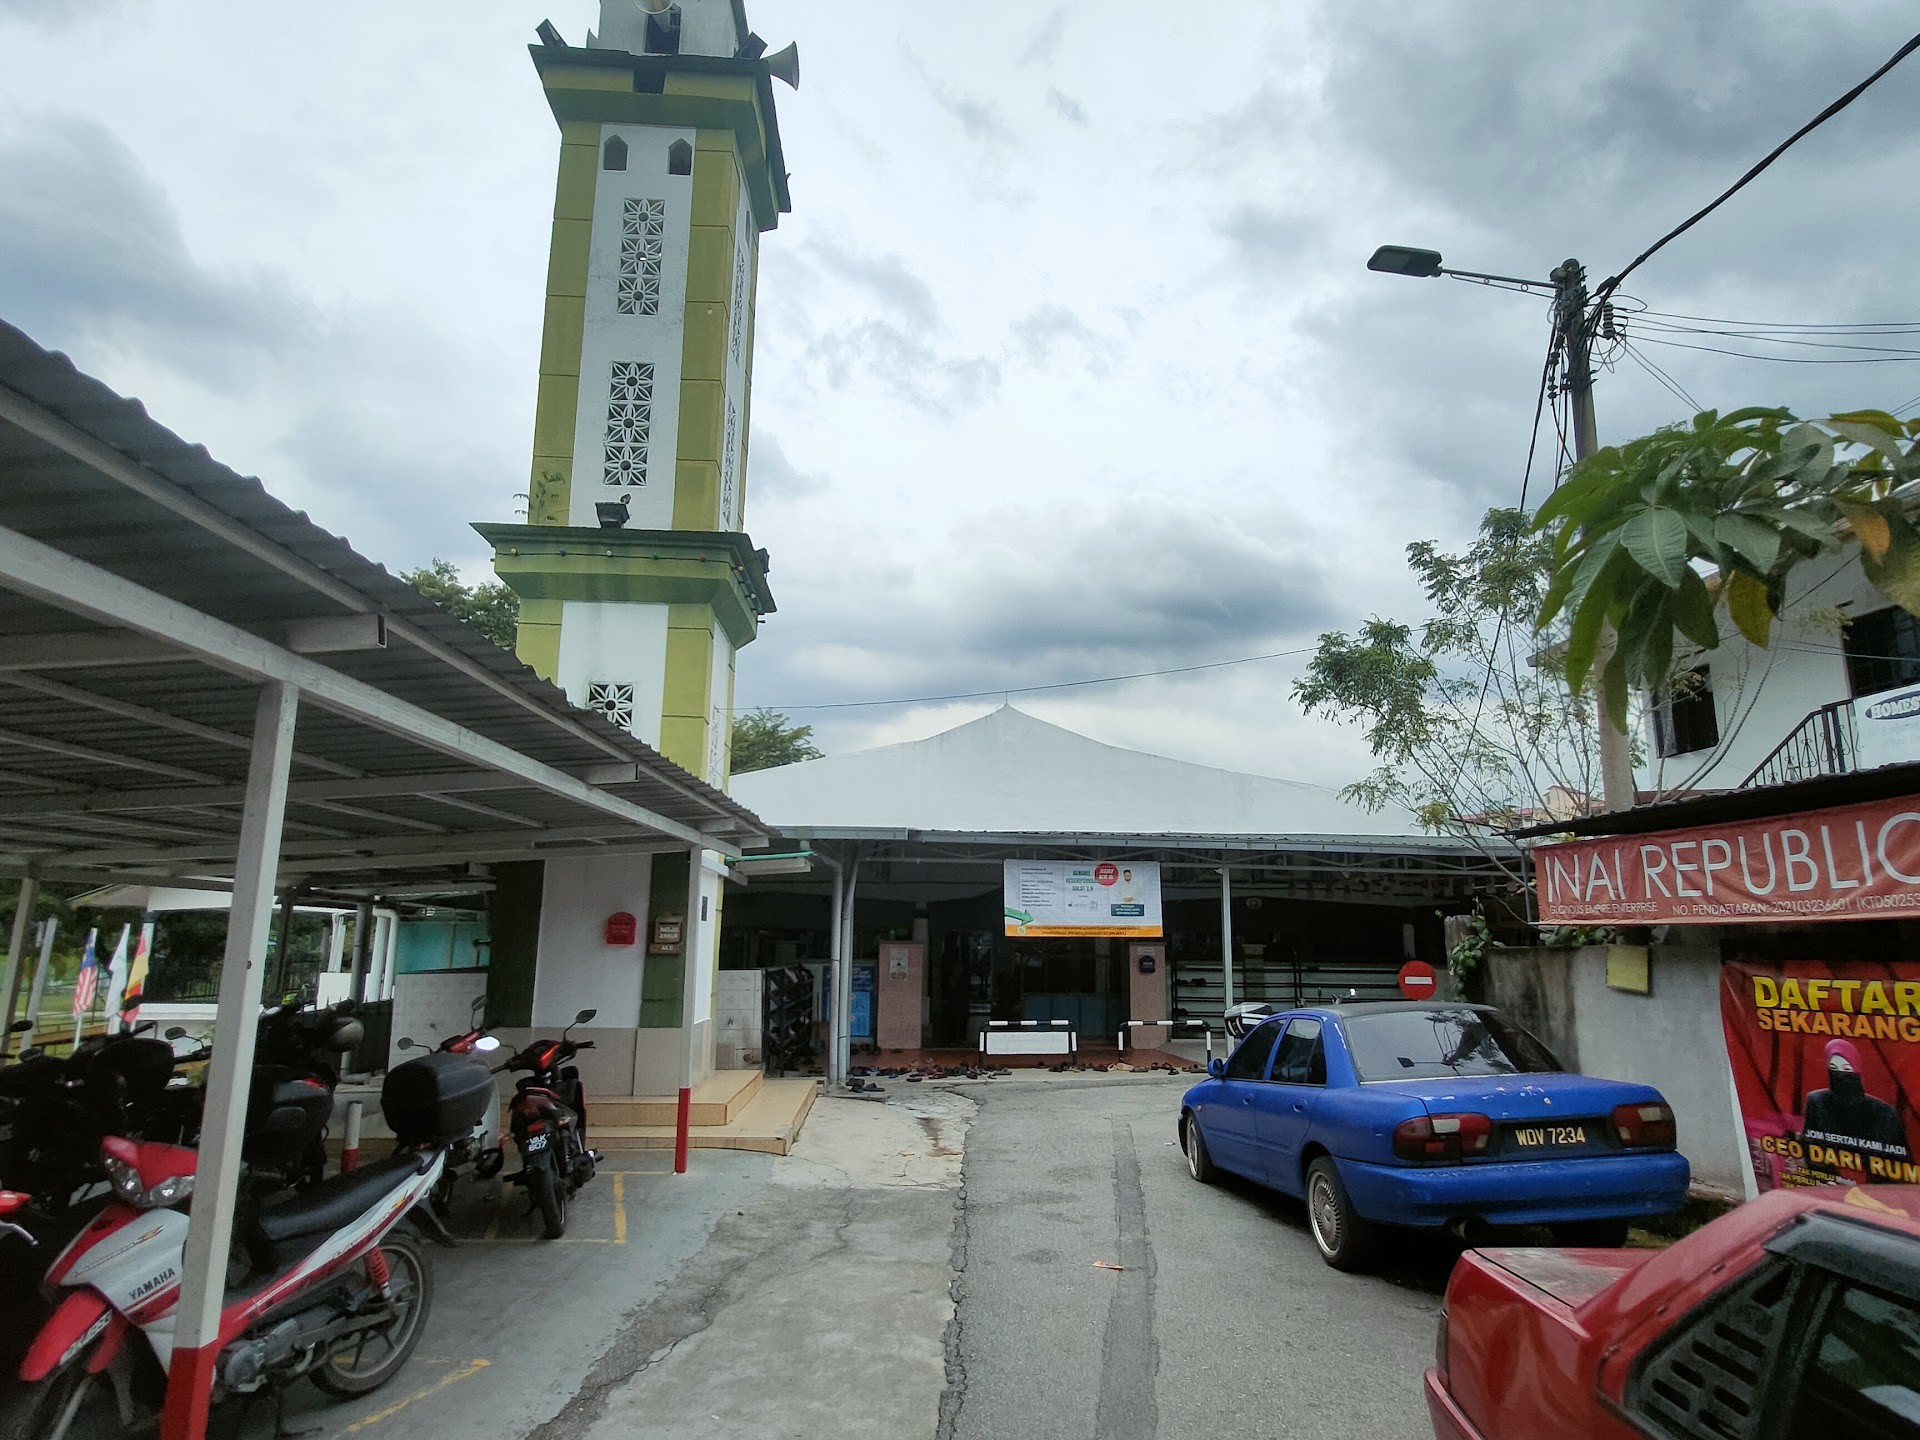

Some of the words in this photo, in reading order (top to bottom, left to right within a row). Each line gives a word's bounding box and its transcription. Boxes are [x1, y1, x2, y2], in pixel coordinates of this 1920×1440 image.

[1872, 695, 1920, 719] HOMES
[1545, 848, 1627, 902] INAI
[1639, 812, 1920, 899] REPUBLIC
[1549, 904, 1584, 915] GLORIOUS
[1612, 901, 1658, 913] ENTERPRISE
[1672, 904, 1691, 916] NO.
[1752, 976, 1920, 1016] DAFTAR
[1756, 1007, 1920, 1043] SEKARANG
[1515, 1128, 1544, 1146] WDV
[1547, 1126, 1586, 1144] 7234
[1805, 1129, 1825, 1140] JOM
[1825, 1132, 1858, 1147] SERTAI
[1858, 1138, 1882, 1152] KAMI
[1884, 1144, 1907, 1156] JADI
[1761, 1135, 1803, 1159] CEO
[1809, 1144, 1862, 1171] DARI
[128, 1267, 176, 1300] YAMAHA
